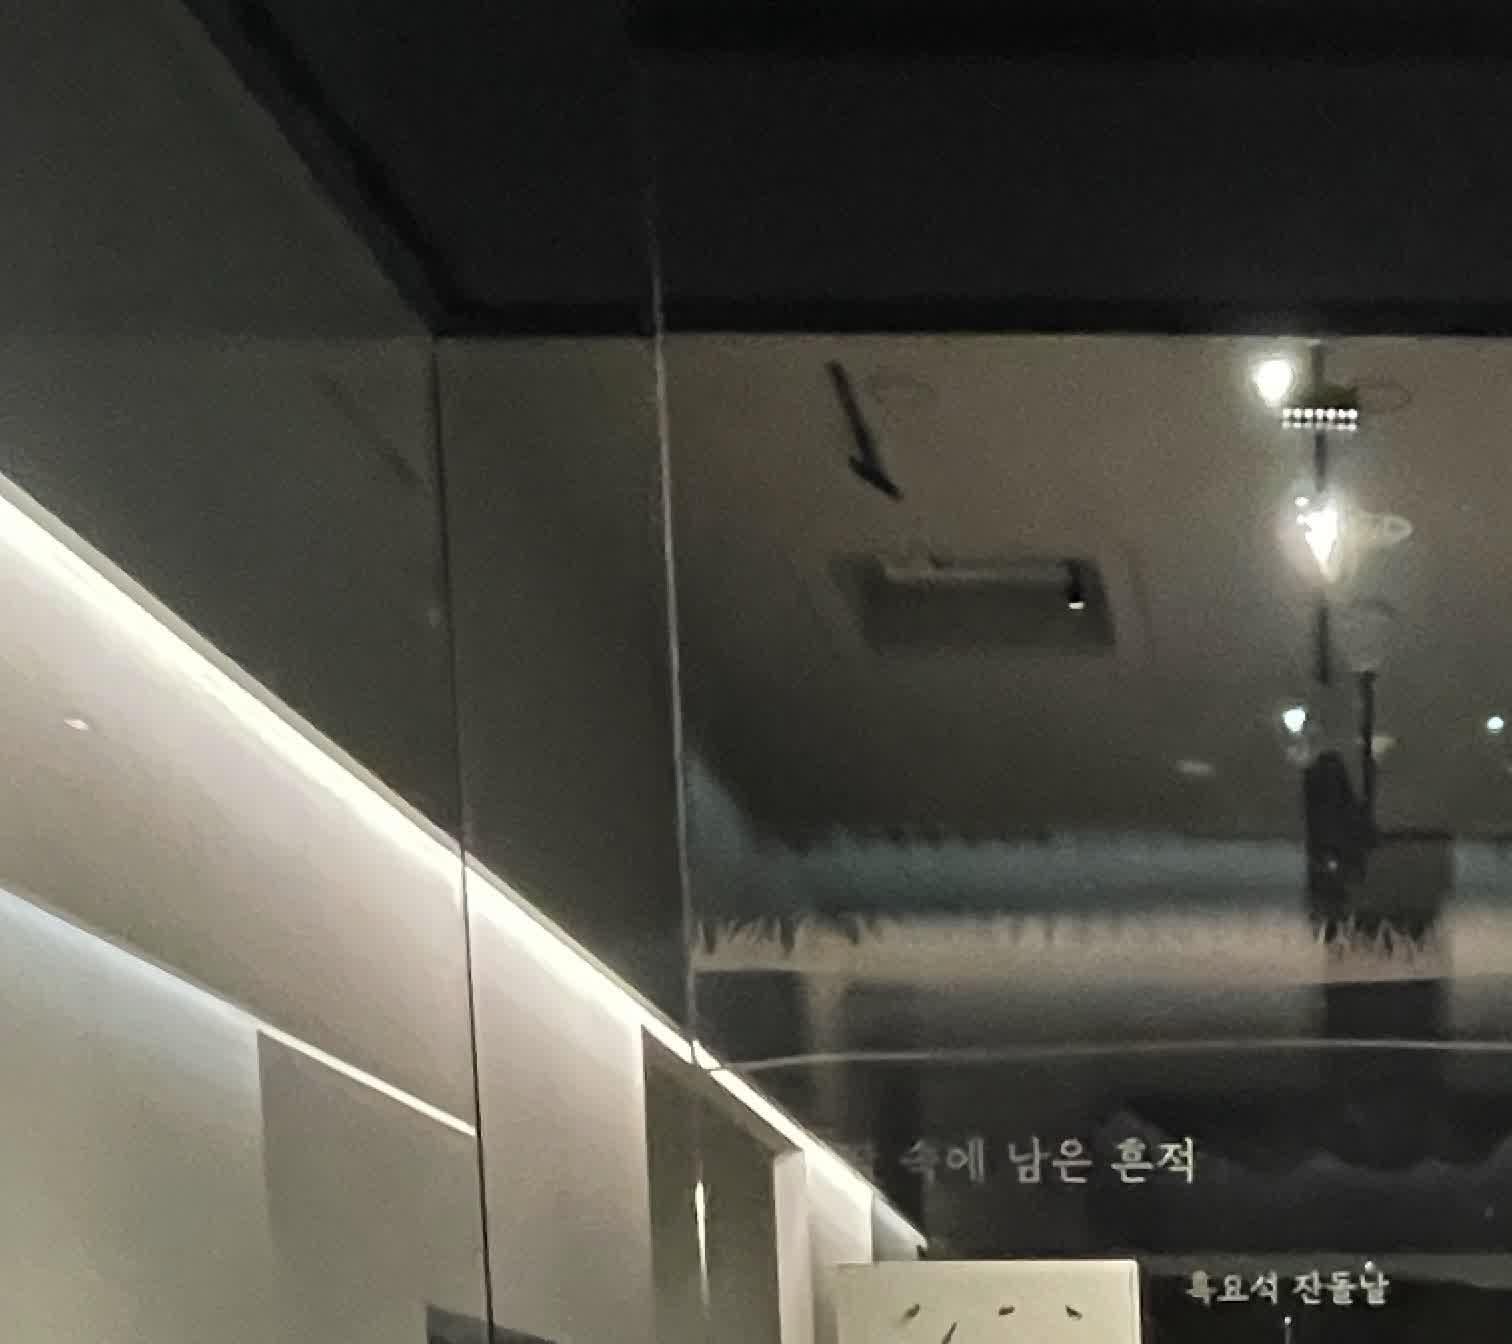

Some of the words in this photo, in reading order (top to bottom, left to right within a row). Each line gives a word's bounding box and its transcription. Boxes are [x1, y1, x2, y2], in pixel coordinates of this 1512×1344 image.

[900, 1136, 985, 1186] 속에
[1008, 1136, 1094, 1184] 남은
[1110, 1135, 1195, 1184] 흔적
[1185, 1269, 1279, 1306] 흑요석
[1292, 1269, 1390, 1306] 잔돌날
